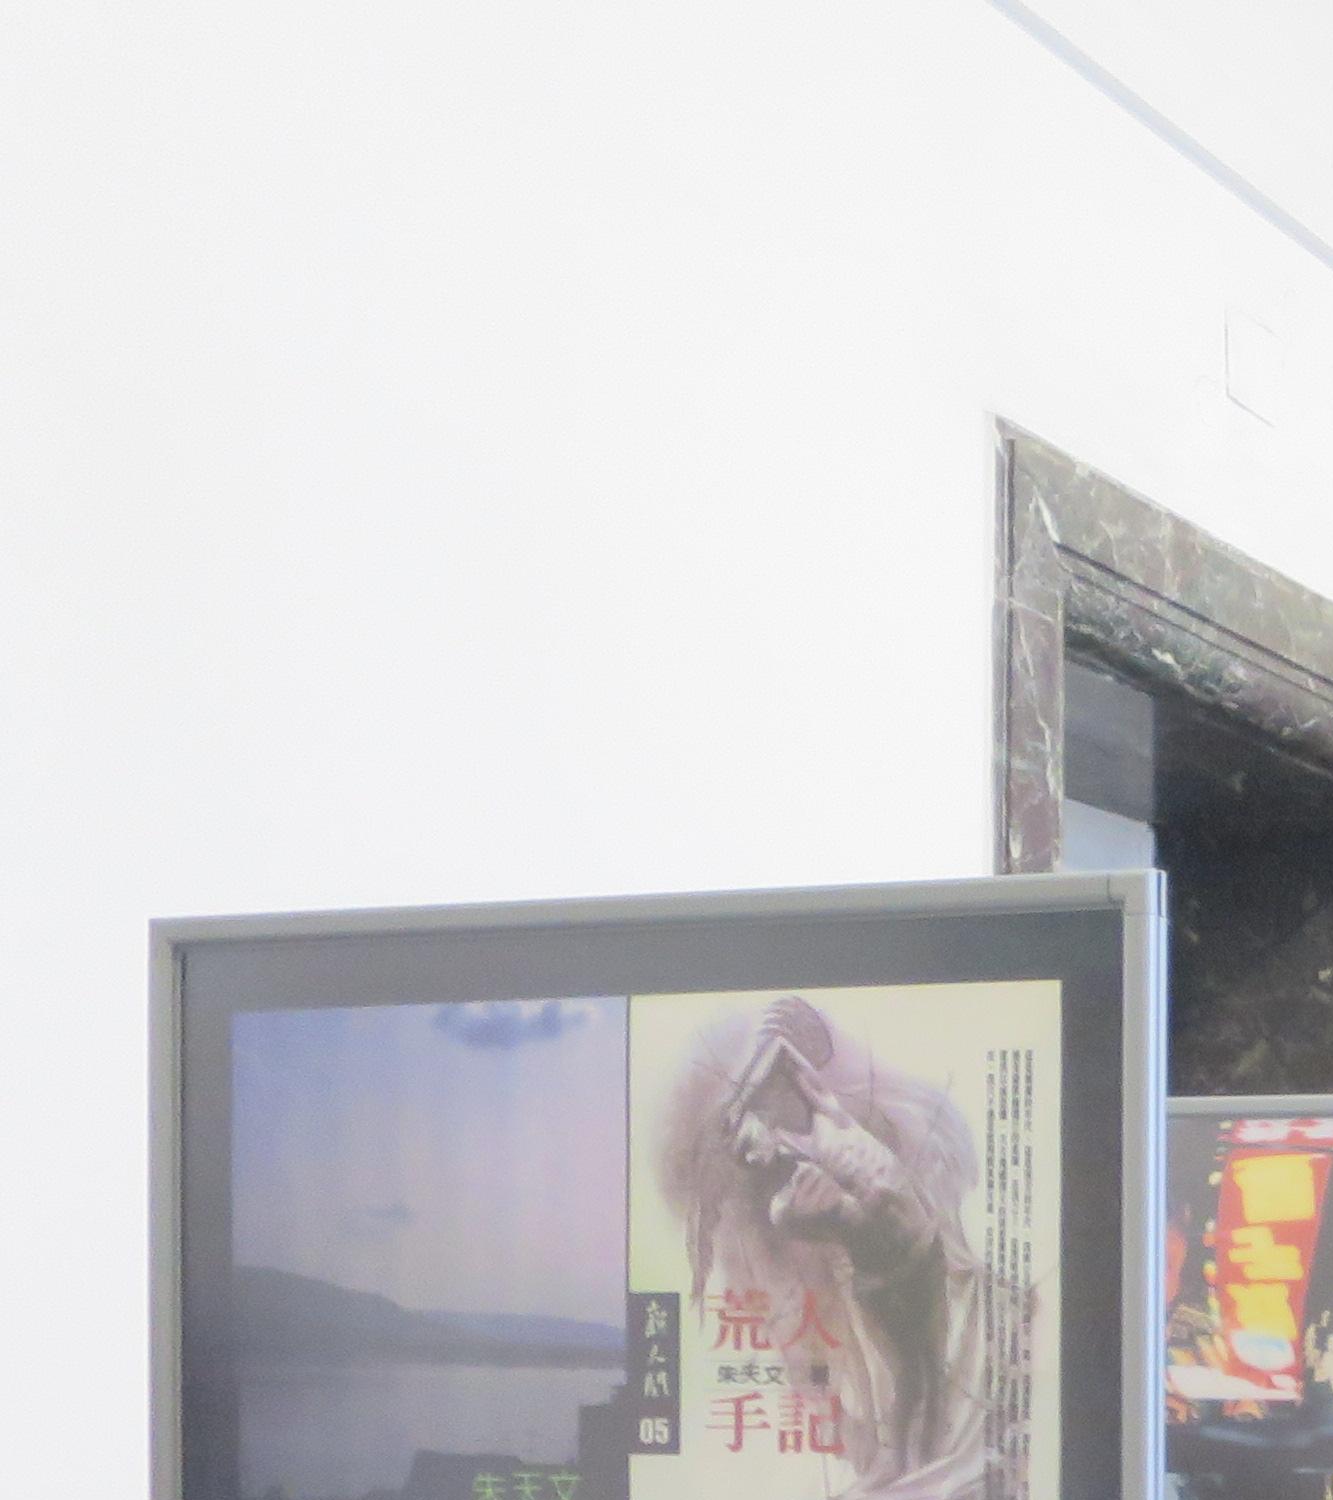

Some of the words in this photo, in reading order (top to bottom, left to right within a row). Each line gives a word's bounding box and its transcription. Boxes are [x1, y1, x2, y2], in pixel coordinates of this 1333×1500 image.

[703, 1288, 842, 1351] 荒人
[716, 1361, 787, 1386] 朱天文
[639, 1417, 669, 1445] 05
[704, 1391, 846, 1454] 手記
